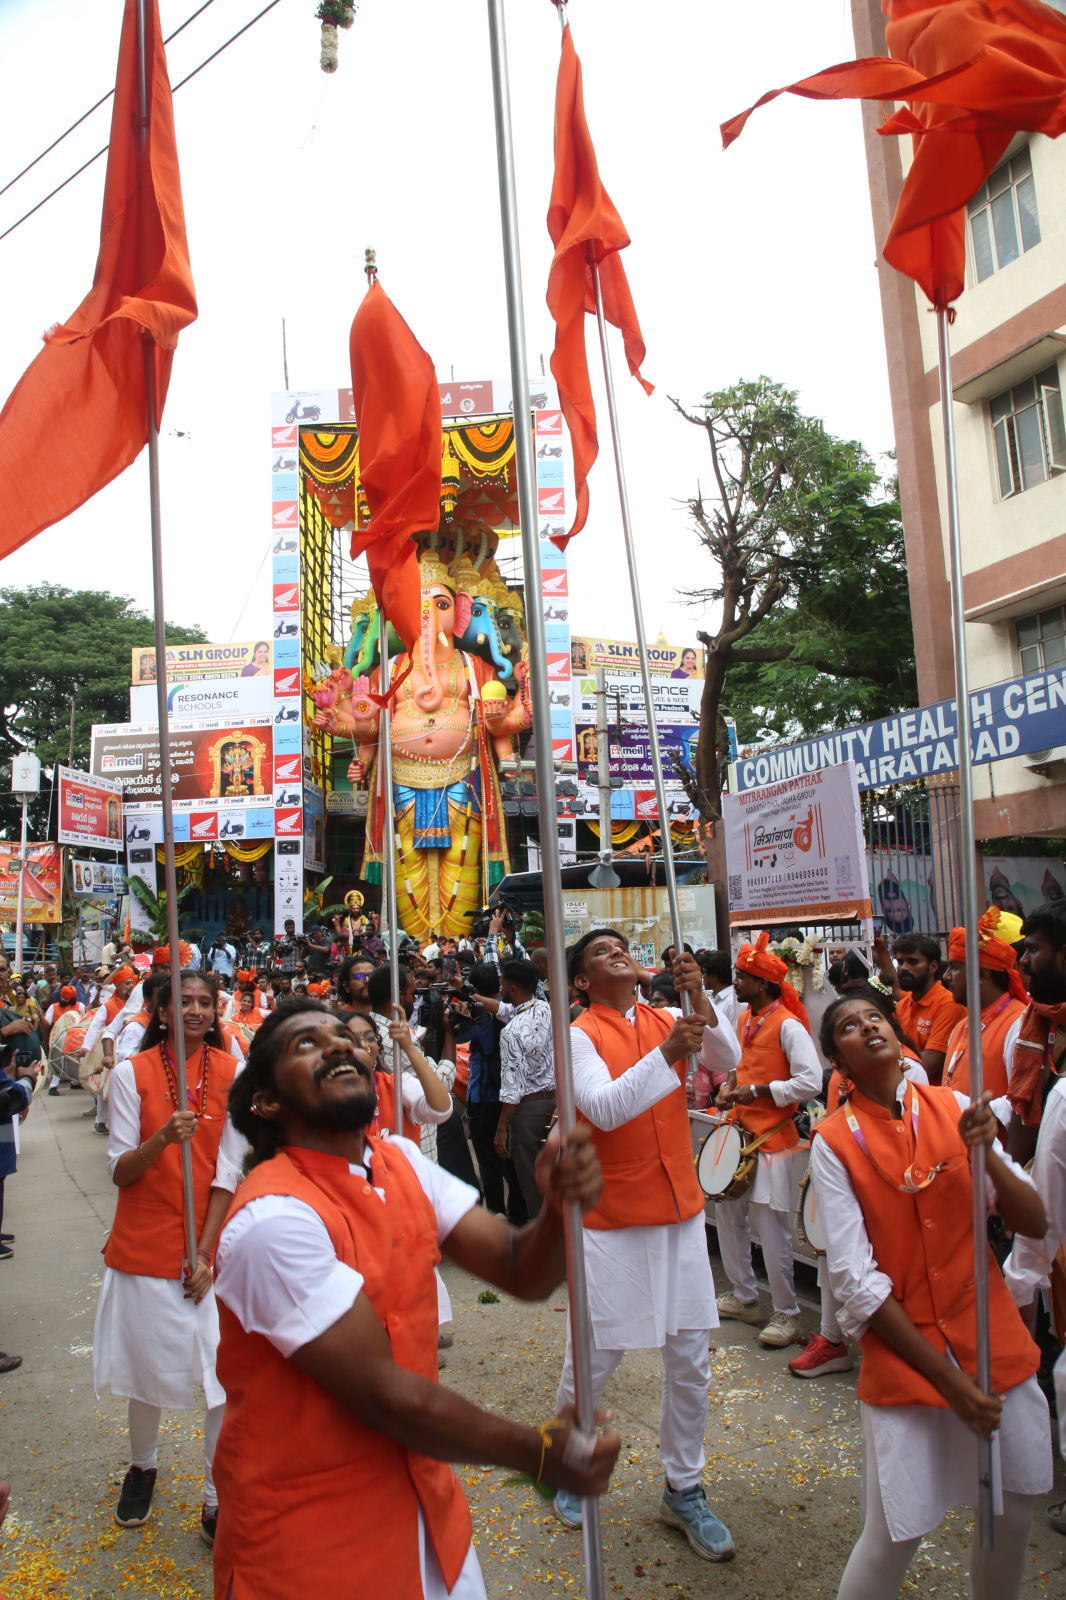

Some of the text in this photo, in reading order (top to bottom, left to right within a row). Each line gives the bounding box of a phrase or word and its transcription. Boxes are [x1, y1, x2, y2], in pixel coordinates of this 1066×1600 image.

[178, 648, 249, 661] SLN GROUP
[608, 645, 633, 657] SLN
[178, 691, 239, 703] RESONANCE
[178, 702, 222, 712] SCHOOLS
[623, 746, 642, 755] meil
[116, 753, 143, 767] meil
[743, 726, 874, 788] COMMUNITY
[739, 772, 823, 806] MITRAANGAN PATHAK
[797, 789, 816, 801] GROUP
